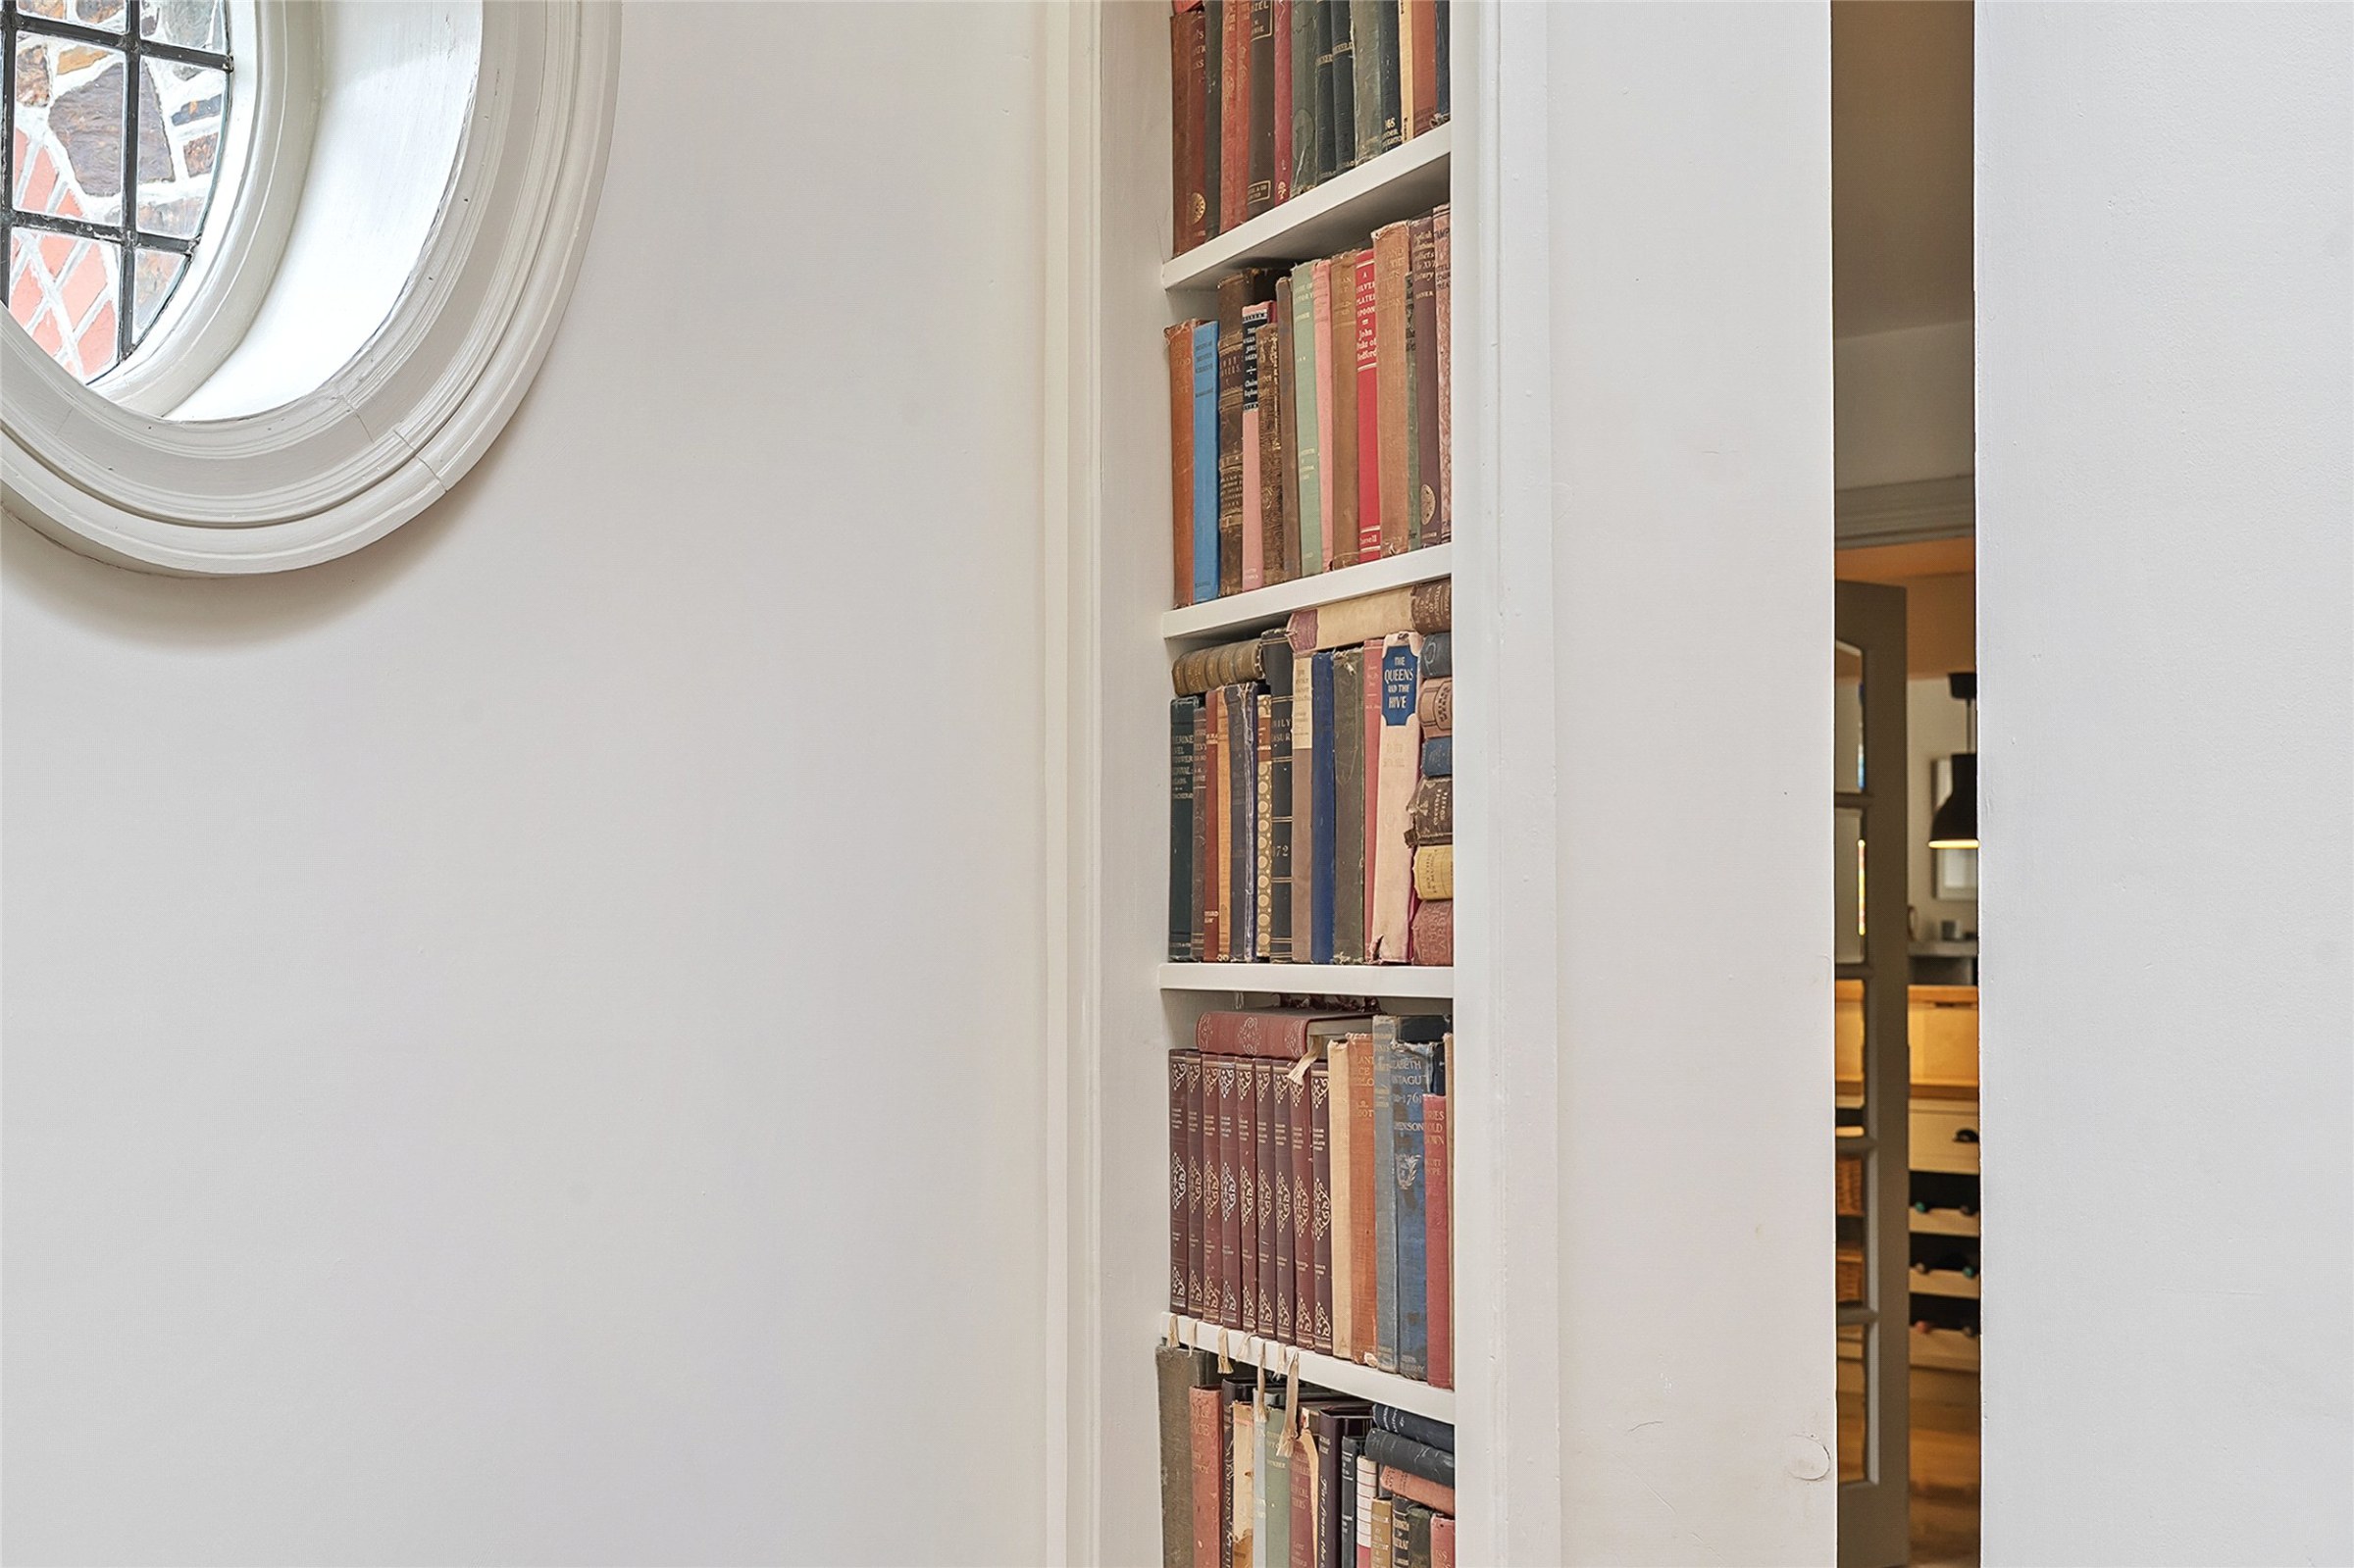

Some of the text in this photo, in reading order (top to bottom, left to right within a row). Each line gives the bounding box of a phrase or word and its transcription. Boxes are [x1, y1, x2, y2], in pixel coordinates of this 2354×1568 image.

[1394, 656, 1406, 666] THE
[1384, 668, 1414, 684] QUEENS
[1398, 683, 1410, 693] THE
[1388, 695, 1407, 709] HIVE
